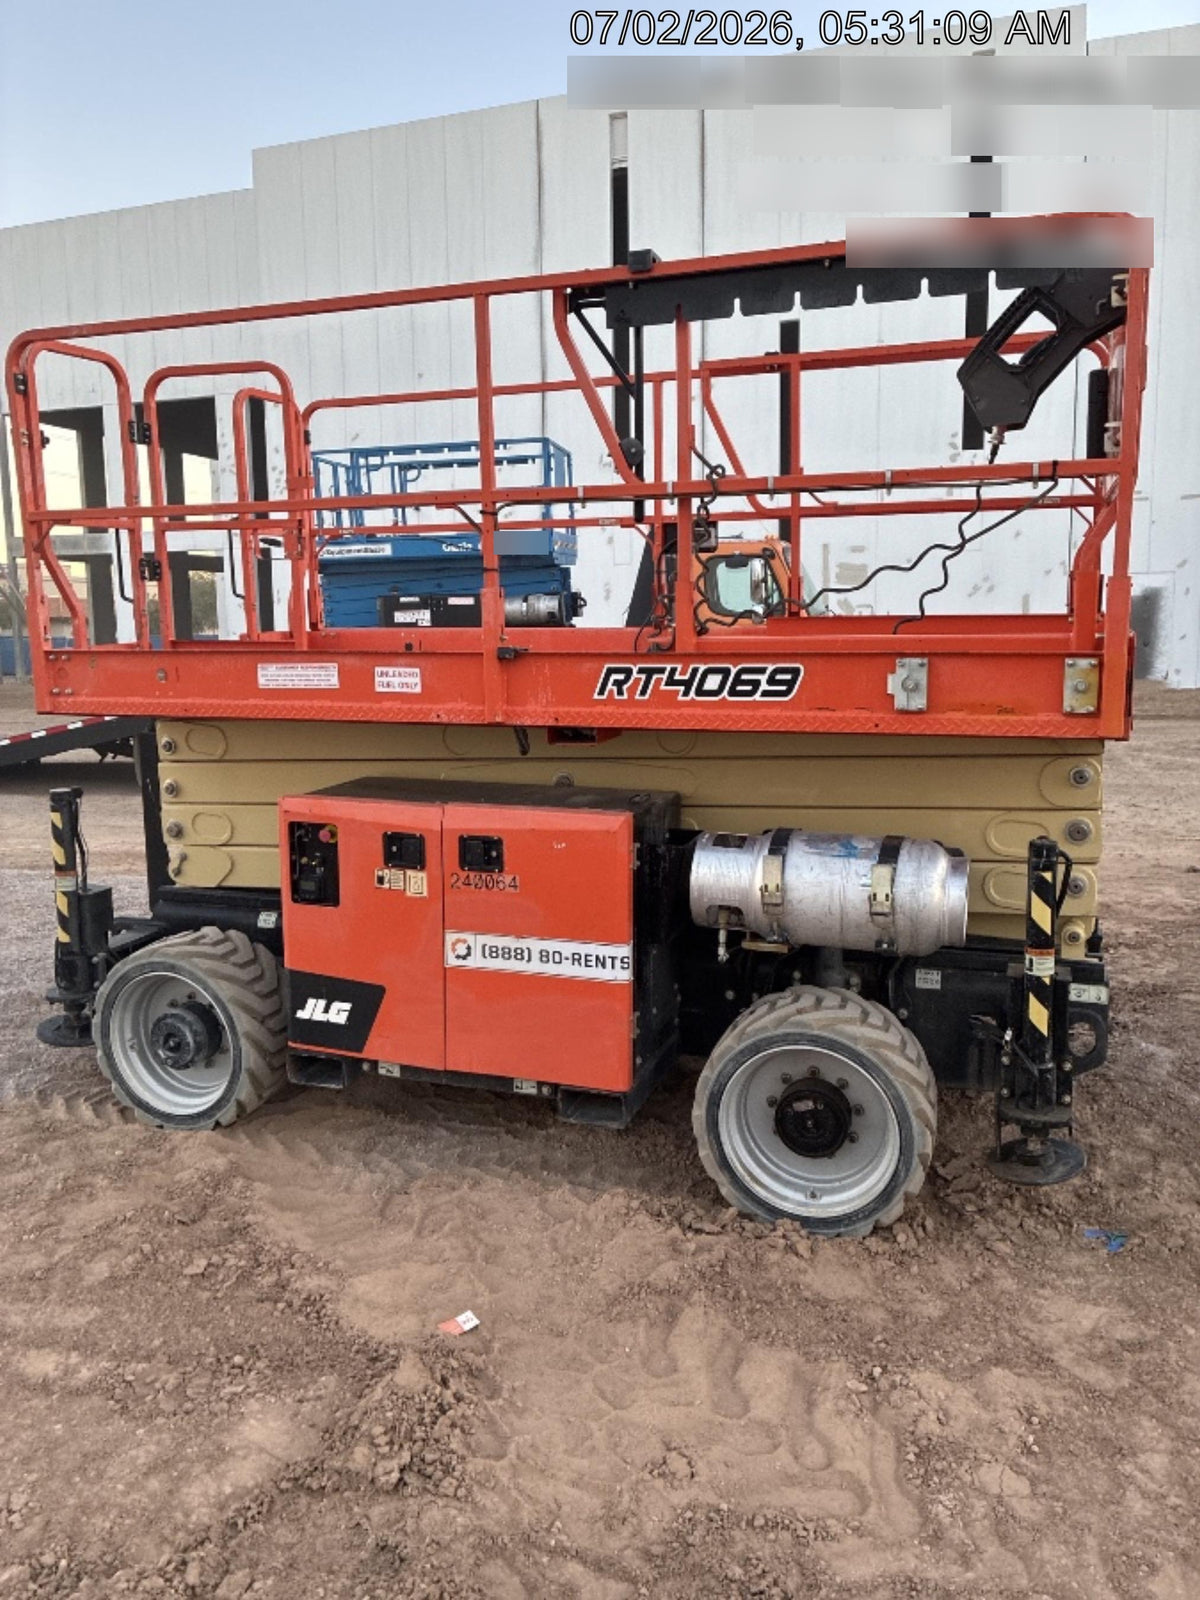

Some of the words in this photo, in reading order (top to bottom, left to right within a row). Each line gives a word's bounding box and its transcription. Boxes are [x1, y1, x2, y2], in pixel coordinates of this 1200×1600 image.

[593, 663, 804, 700] RT4069
[481, 944, 532, 963] (888)
[539, 949, 631, 970] 80-RENTS
[295, 997, 352, 1024] JLG
